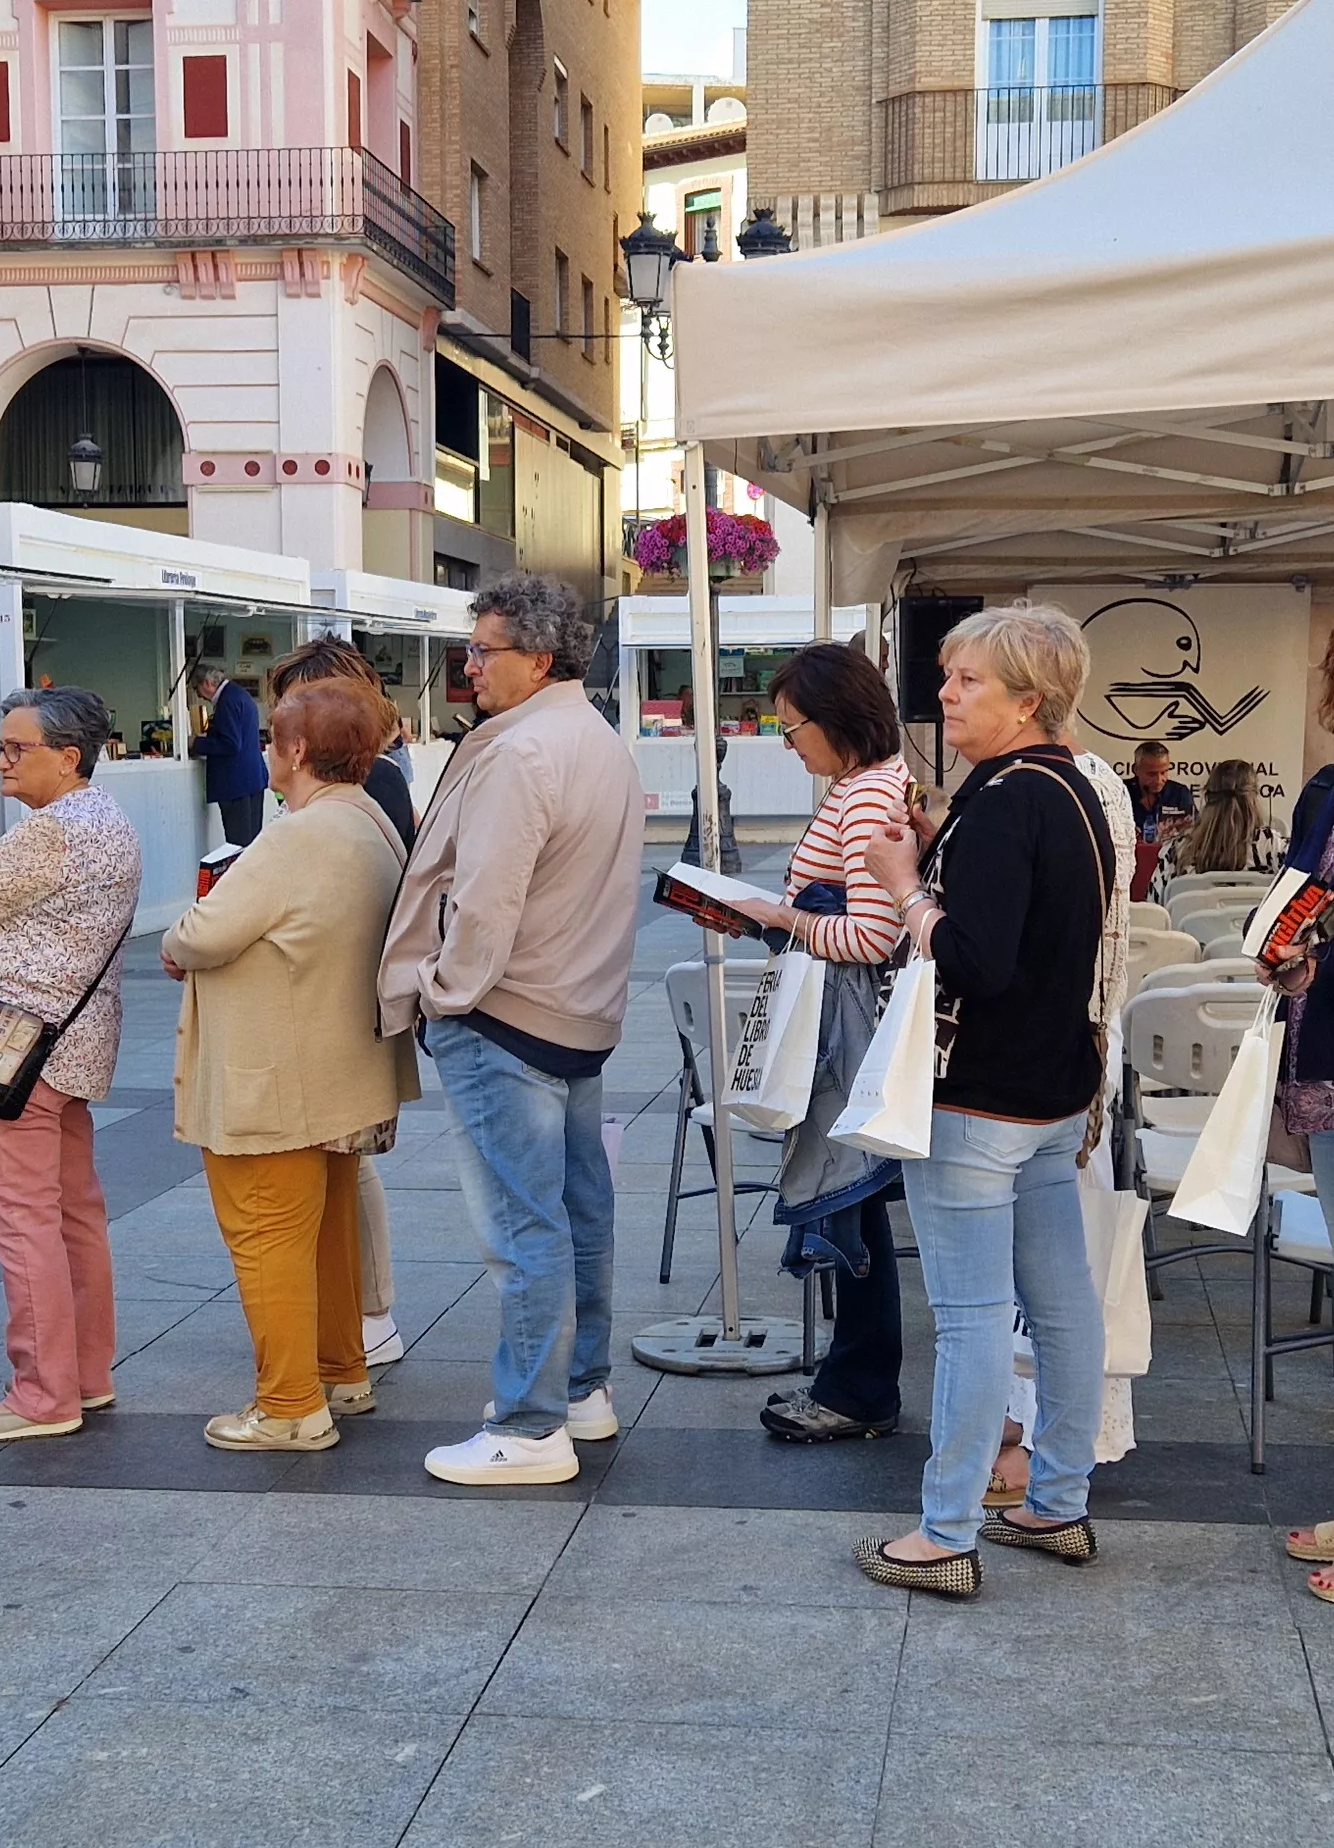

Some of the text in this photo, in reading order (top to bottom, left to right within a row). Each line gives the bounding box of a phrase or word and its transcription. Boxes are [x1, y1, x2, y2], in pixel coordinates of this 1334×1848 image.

[1168, 761, 1279, 776] PROVAL
[750, 995, 769, 1018] DEL
[737, 1044, 754, 1067] DE
